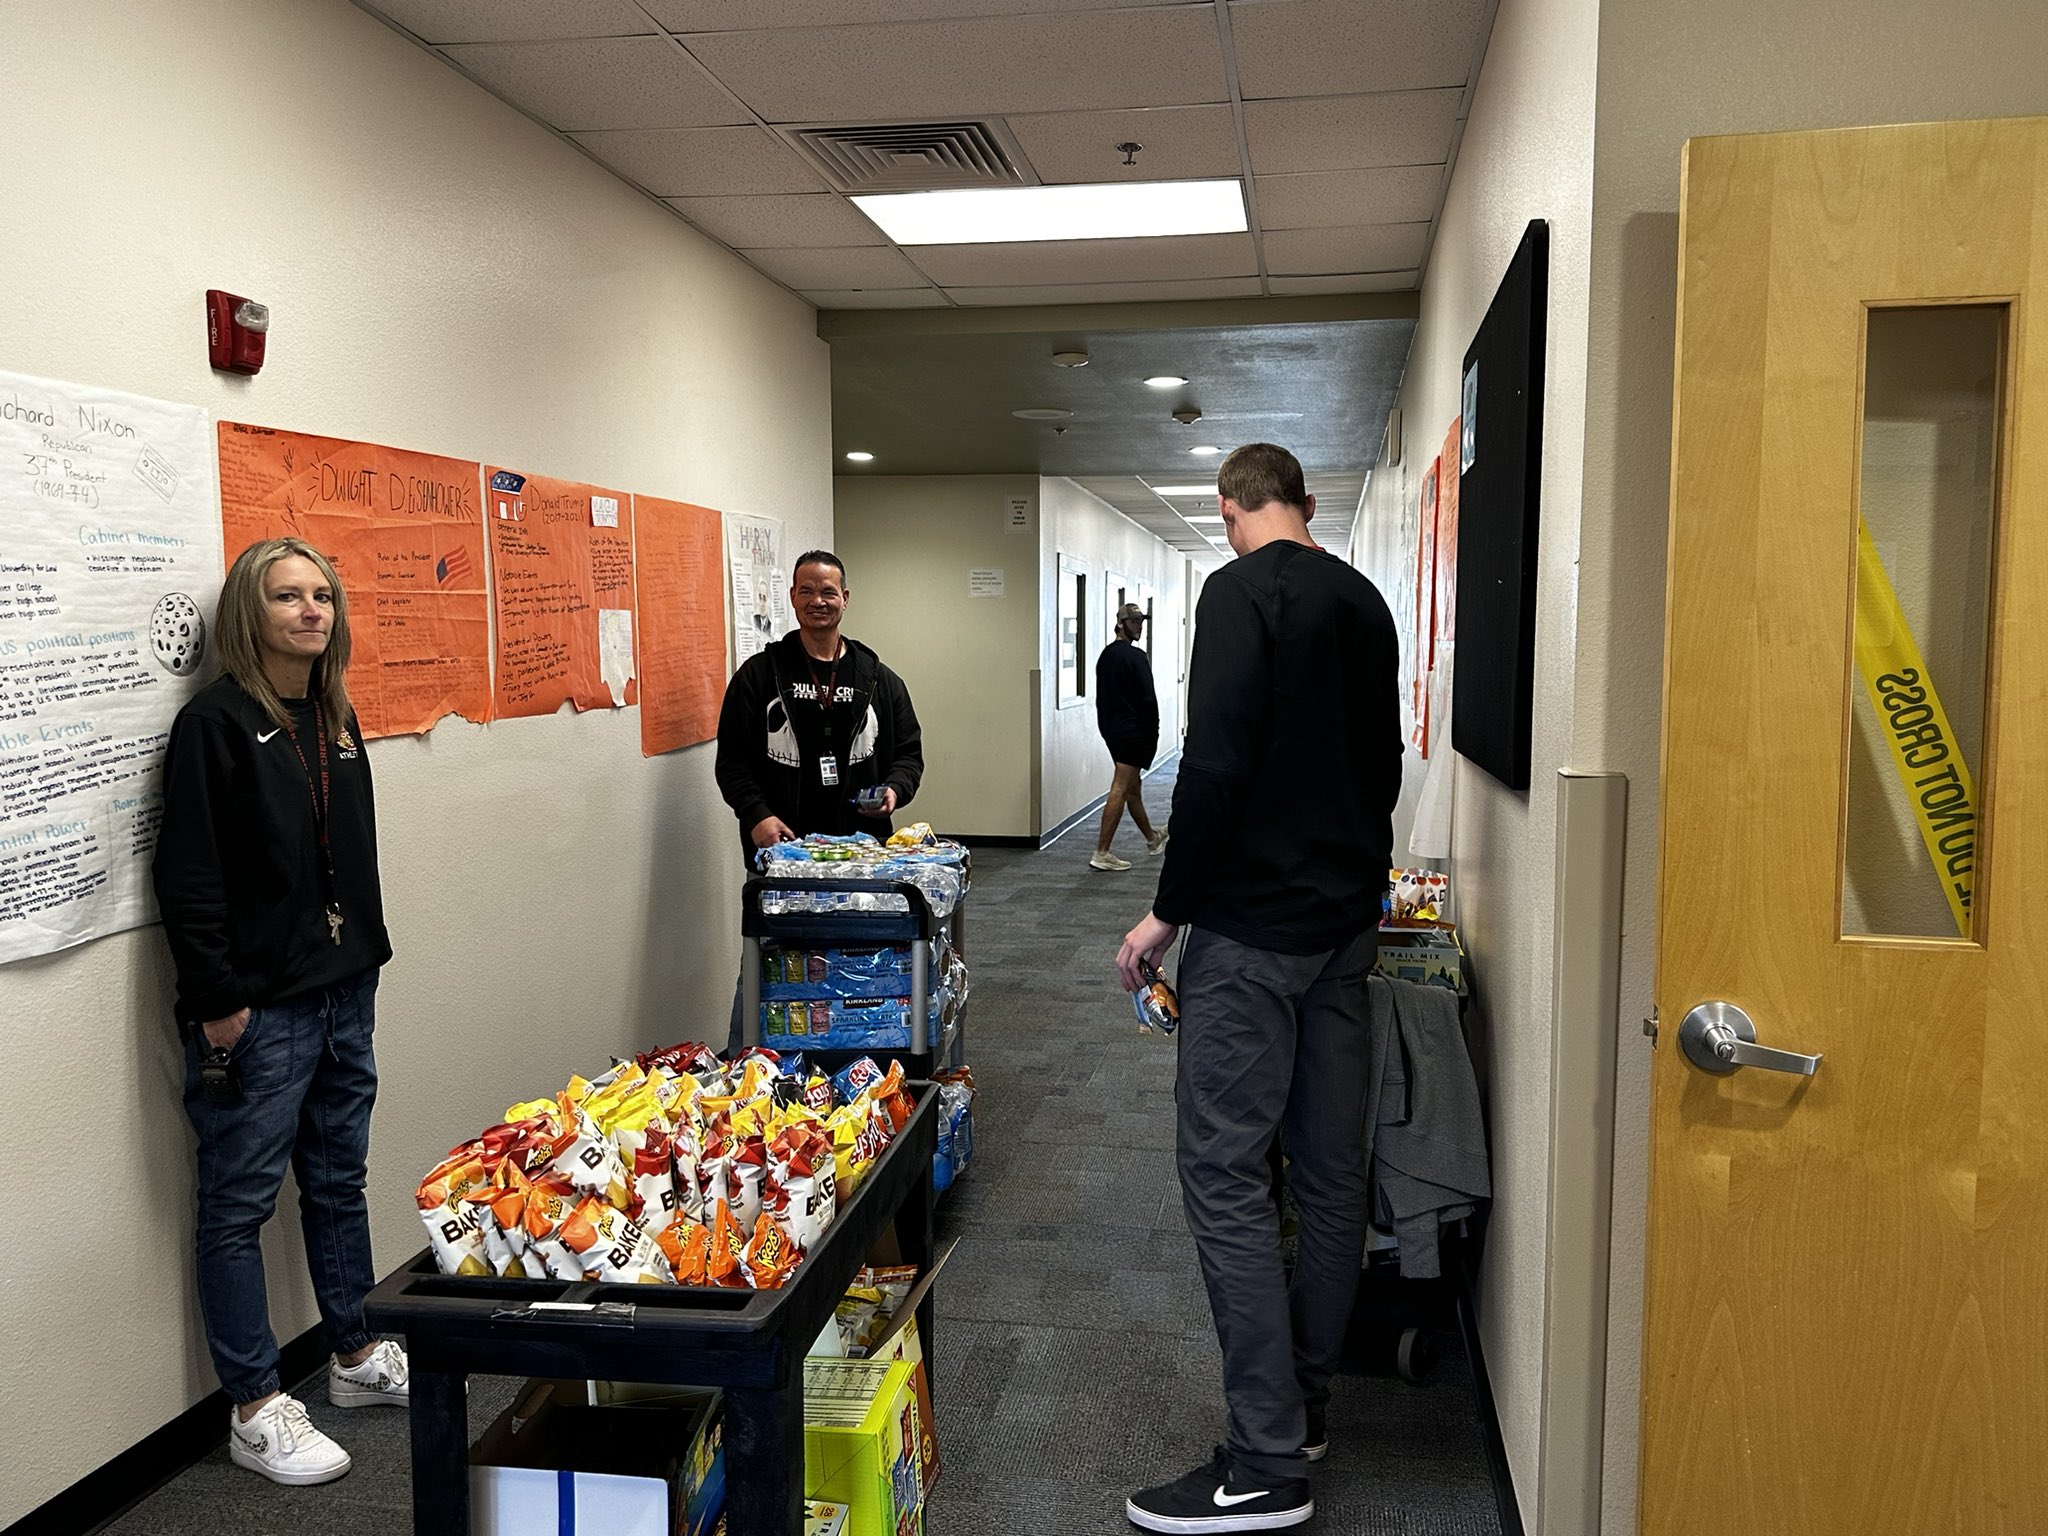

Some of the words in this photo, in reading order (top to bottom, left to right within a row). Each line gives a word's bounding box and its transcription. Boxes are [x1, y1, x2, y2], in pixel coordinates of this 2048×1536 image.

[210, 308, 218, 346] FIRE
[79, 405, 136, 439] Nixon
[42, 433, 93, 454] Republican
[63, 459, 107, 483] President
[321, 463, 378, 507] DWIGHT
[79, 525, 131, 546] Cabinet
[16, 583, 43, 594] College
[35, 594, 58, 604] school
[38, 607, 62, 617] school
[26, 633, 84, 657] political
[89, 629, 136, 650] positions
[60, 656, 76, 666] and
[35, 670, 72, 684] president
[40, 720, 95, 742] Events
[44, 821, 88, 840] Power
[1383, 951, 1414, 960] TRAIL
[1420, 952, 1440, 961] MIX
